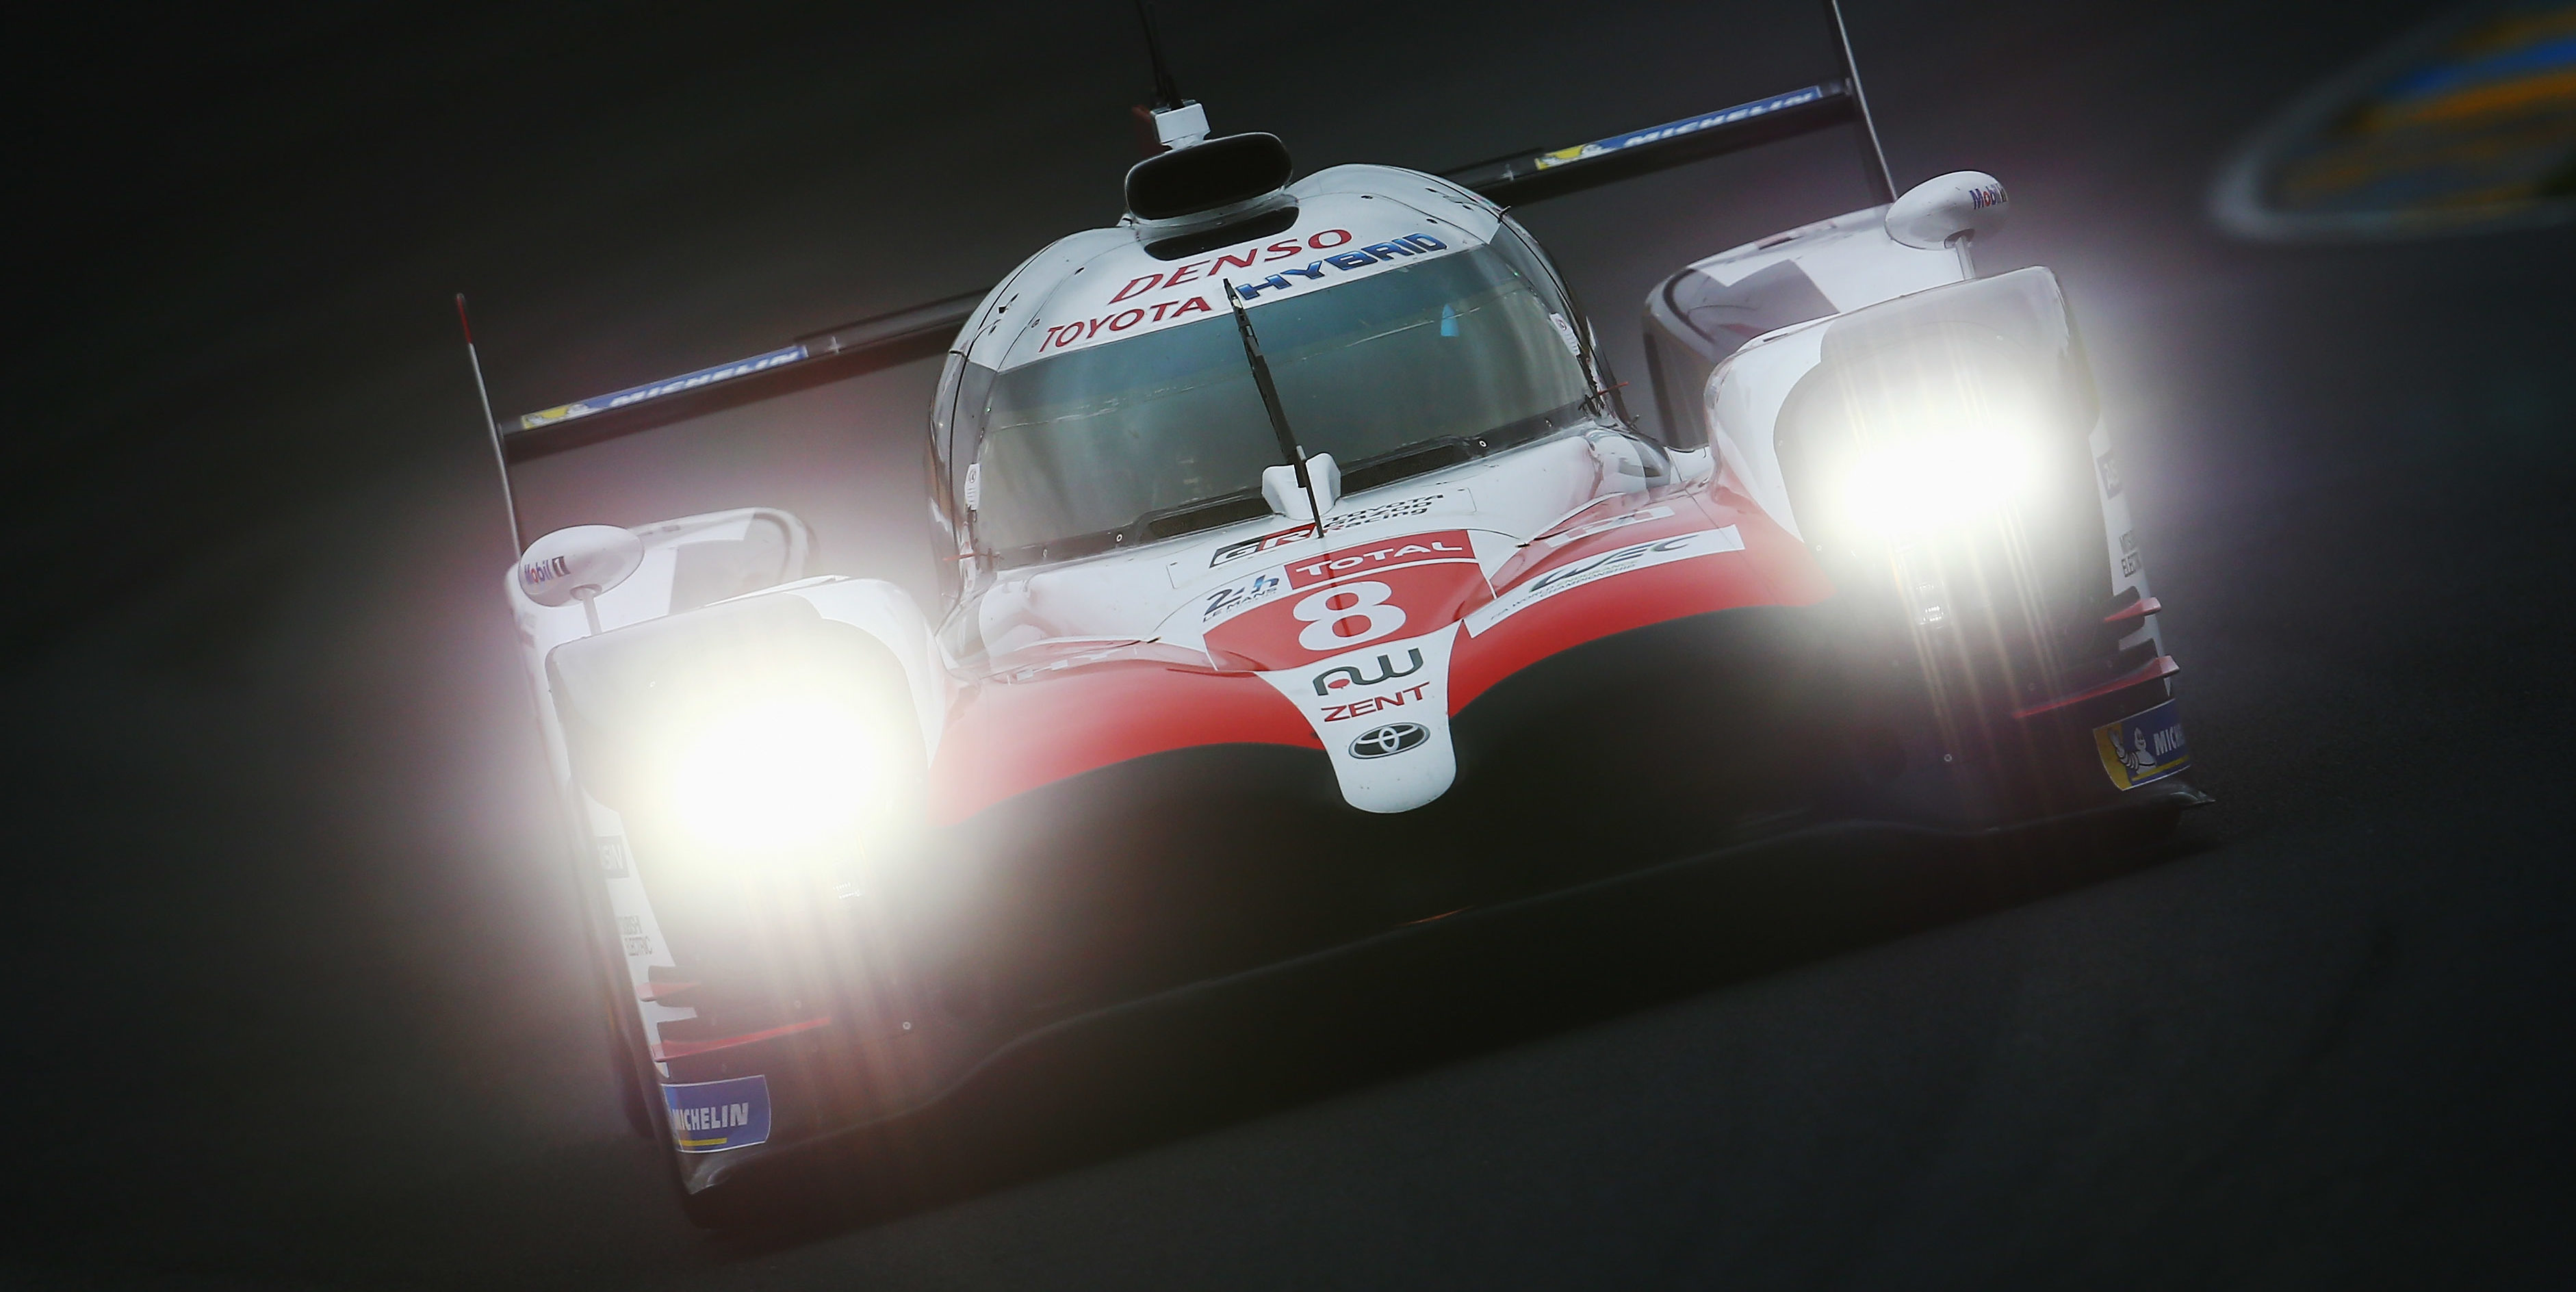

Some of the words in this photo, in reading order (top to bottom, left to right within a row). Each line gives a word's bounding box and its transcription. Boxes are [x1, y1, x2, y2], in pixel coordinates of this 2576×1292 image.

[1623, 92, 1814, 148] MICHELIN
[1969, 185, 2001, 210] Mobil
[1107, 229, 1352, 305] DENSO
[1038, 296, 1213, 353] TOYOTA
[1235, 232, 1448, 301] HYBRID
[609, 350, 800, 410] MICHELIN
[1323, 501, 1432, 529] GAZOO
[1325, 493, 1445, 523] TOYOTA
[1211, 525, 1317, 567] GR
[1296, 541, 1463, 576] TOTAL
[1529, 534, 1699, 593] WEC
[524, 559, 554, 585] Mobil
[1202, 608, 1224, 623] LE
[1226, 588, 1278, 610] MANS
[1293, 580, 1406, 651] 8
[1321, 681, 1430, 723] ZENT
[672, 1102, 749, 1131] MICHELIN
